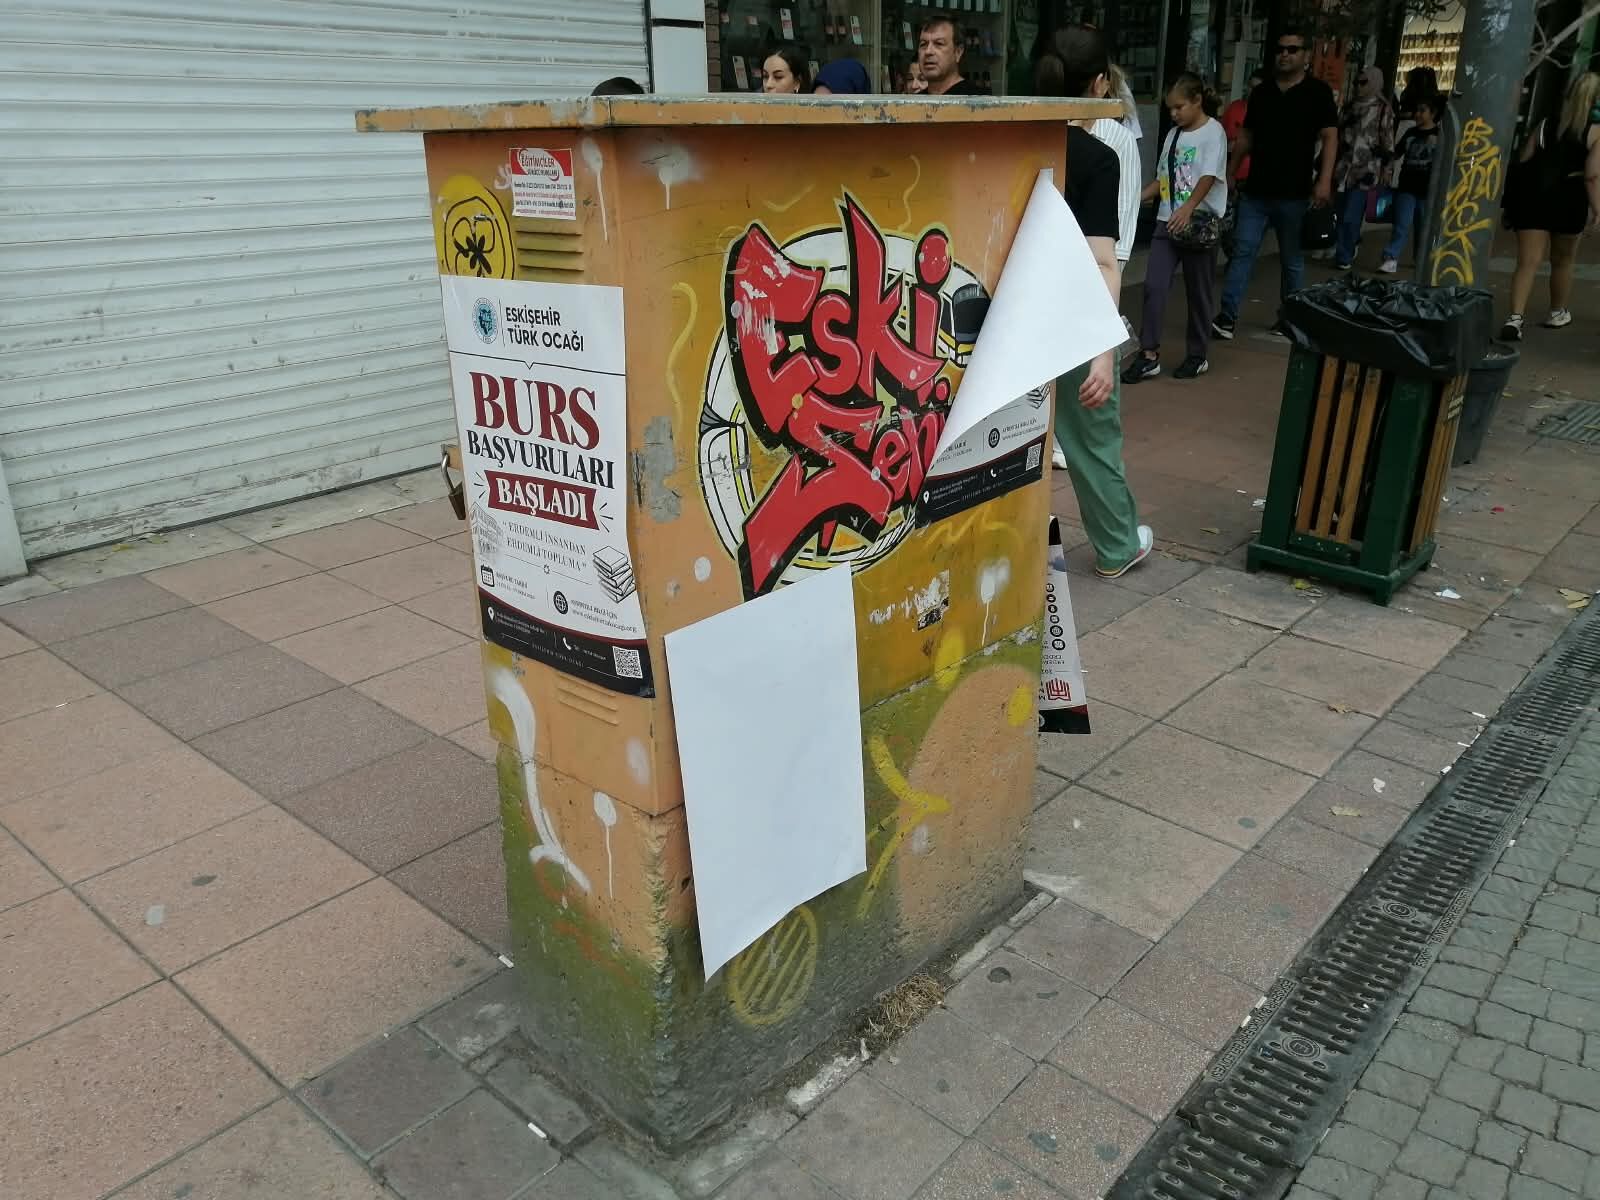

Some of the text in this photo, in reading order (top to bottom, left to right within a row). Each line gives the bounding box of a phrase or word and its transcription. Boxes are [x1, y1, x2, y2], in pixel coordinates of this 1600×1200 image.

[505, 304, 561, 328] ESKİŞEHİR
[507, 324, 584, 352] TÜRK OCAĞI
[468, 371, 600, 451] BURS
[466, 429, 616, 490] BAŞVURULARI
[496, 477, 588, 521] BAŞLADI
